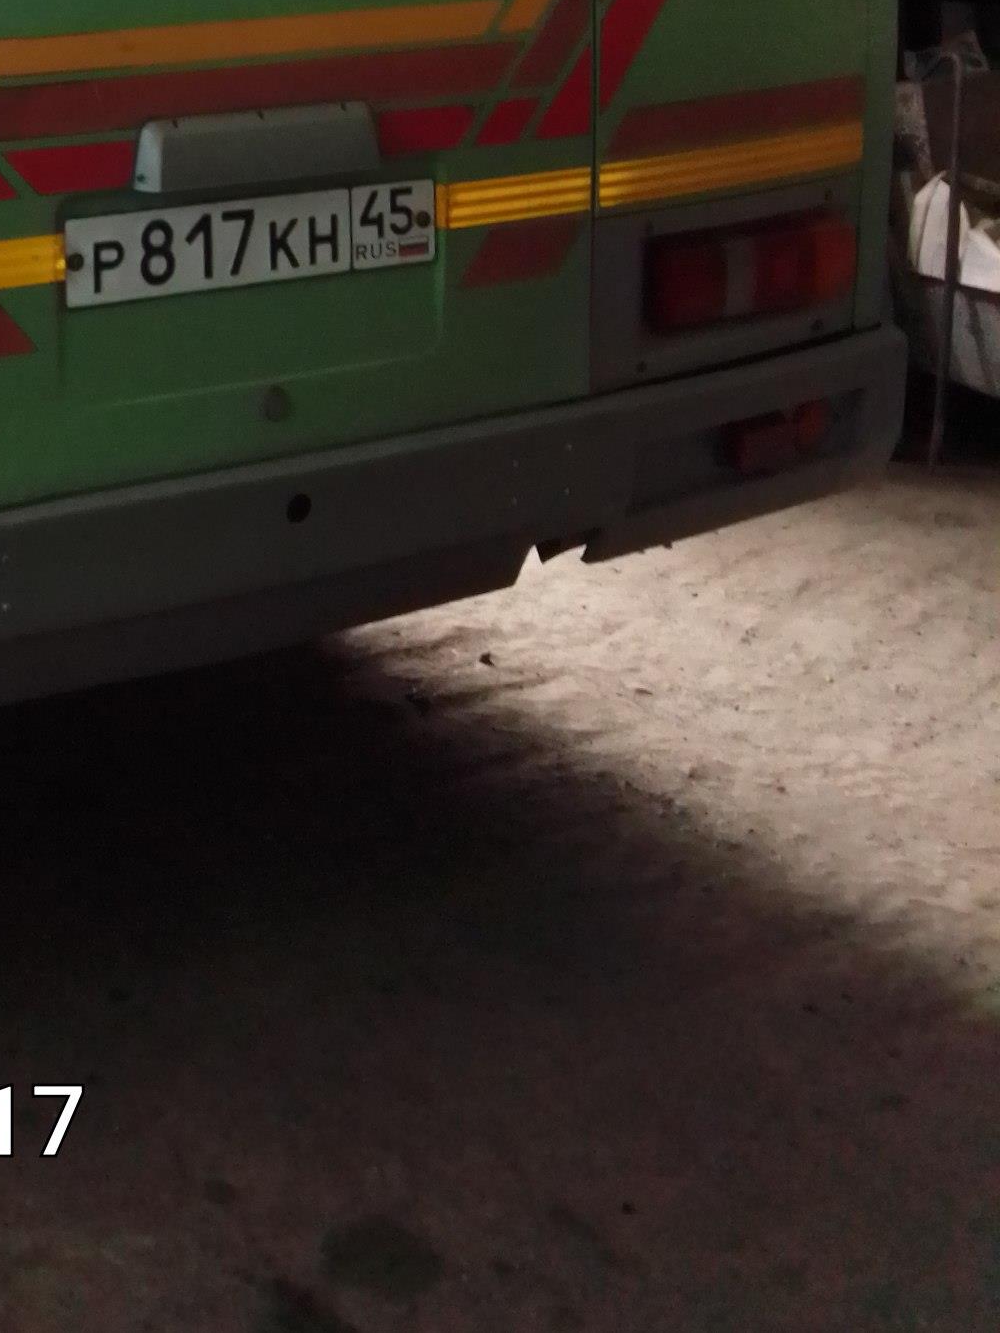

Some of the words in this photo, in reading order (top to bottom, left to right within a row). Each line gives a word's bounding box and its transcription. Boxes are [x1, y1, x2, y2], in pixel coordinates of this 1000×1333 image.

[92, 209, 340, 294] Р817КН
[359, 187, 414, 238] 45
[355, 242, 397, 261] RUS
